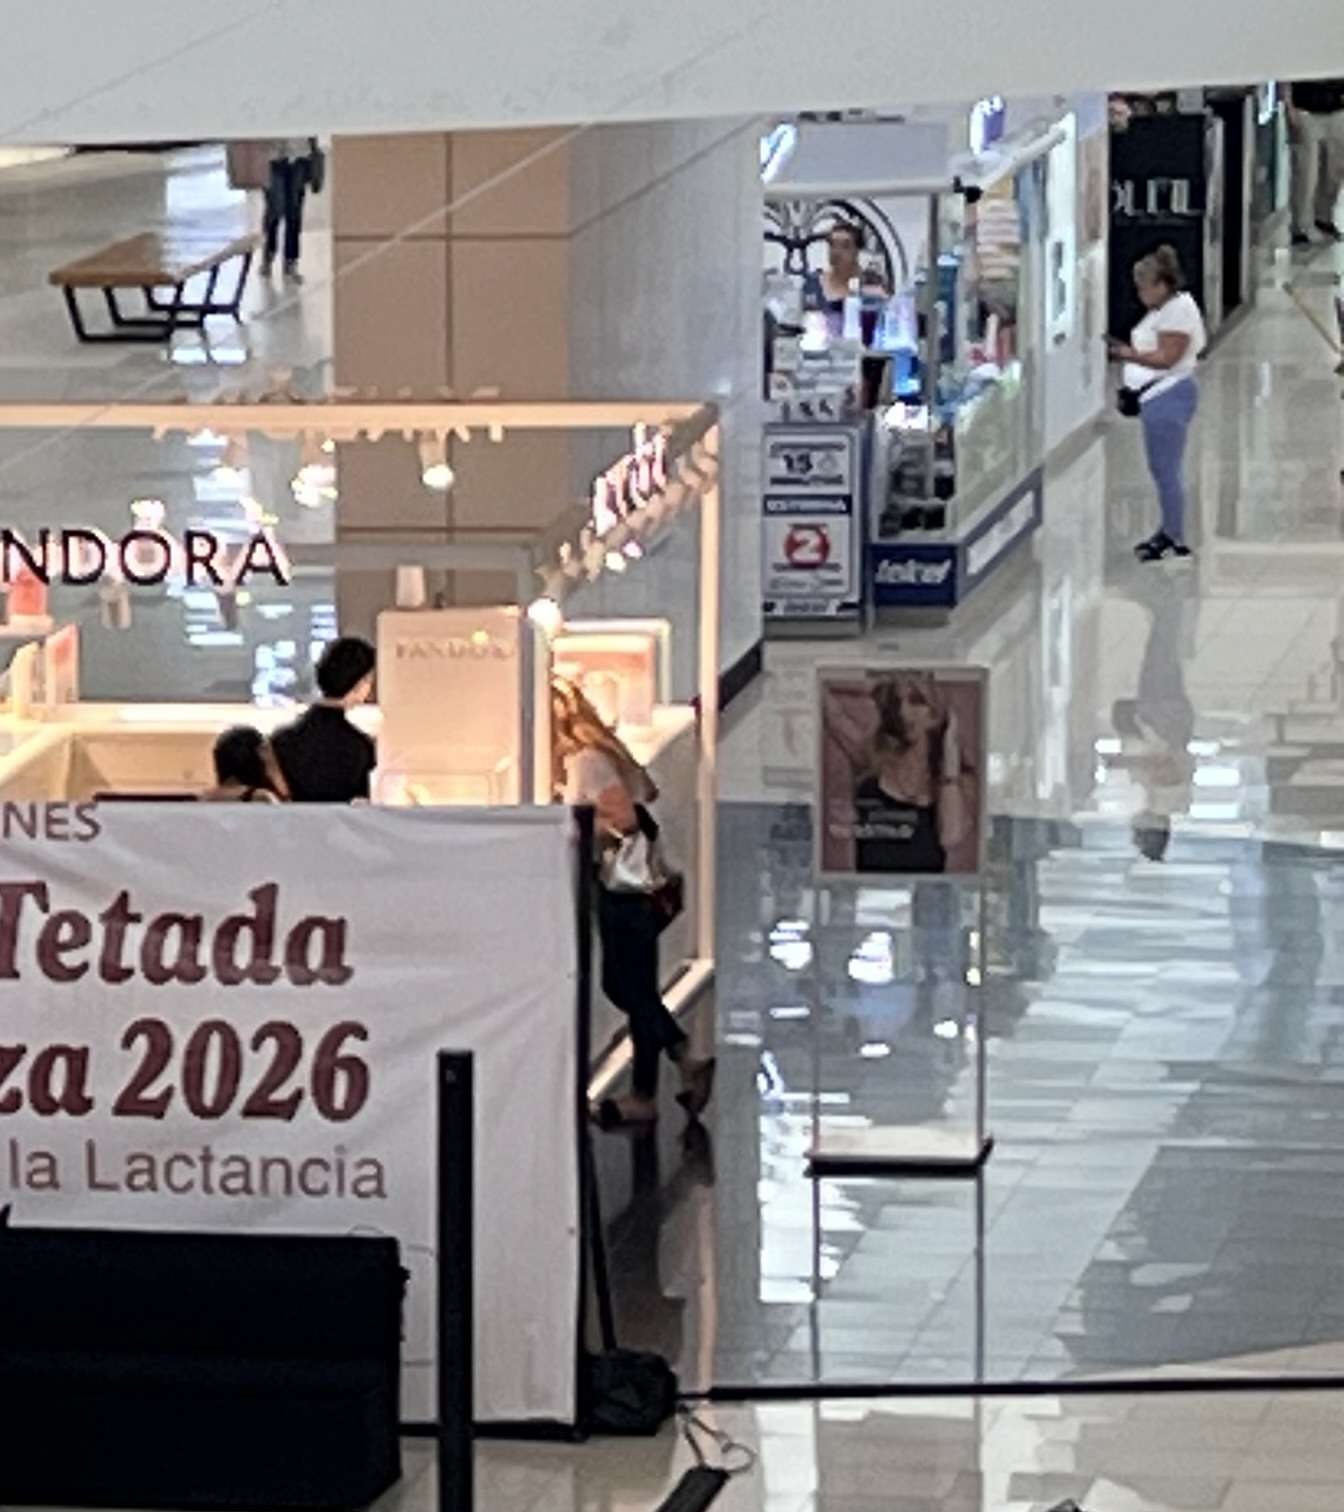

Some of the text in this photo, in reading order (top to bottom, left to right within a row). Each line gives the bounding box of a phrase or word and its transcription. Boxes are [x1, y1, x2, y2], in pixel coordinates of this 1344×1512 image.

[112, 1018, 371, 1122] 2026
[10, 1137, 61, 1192] la
[86, 1138, 388, 1200] Lactancia
